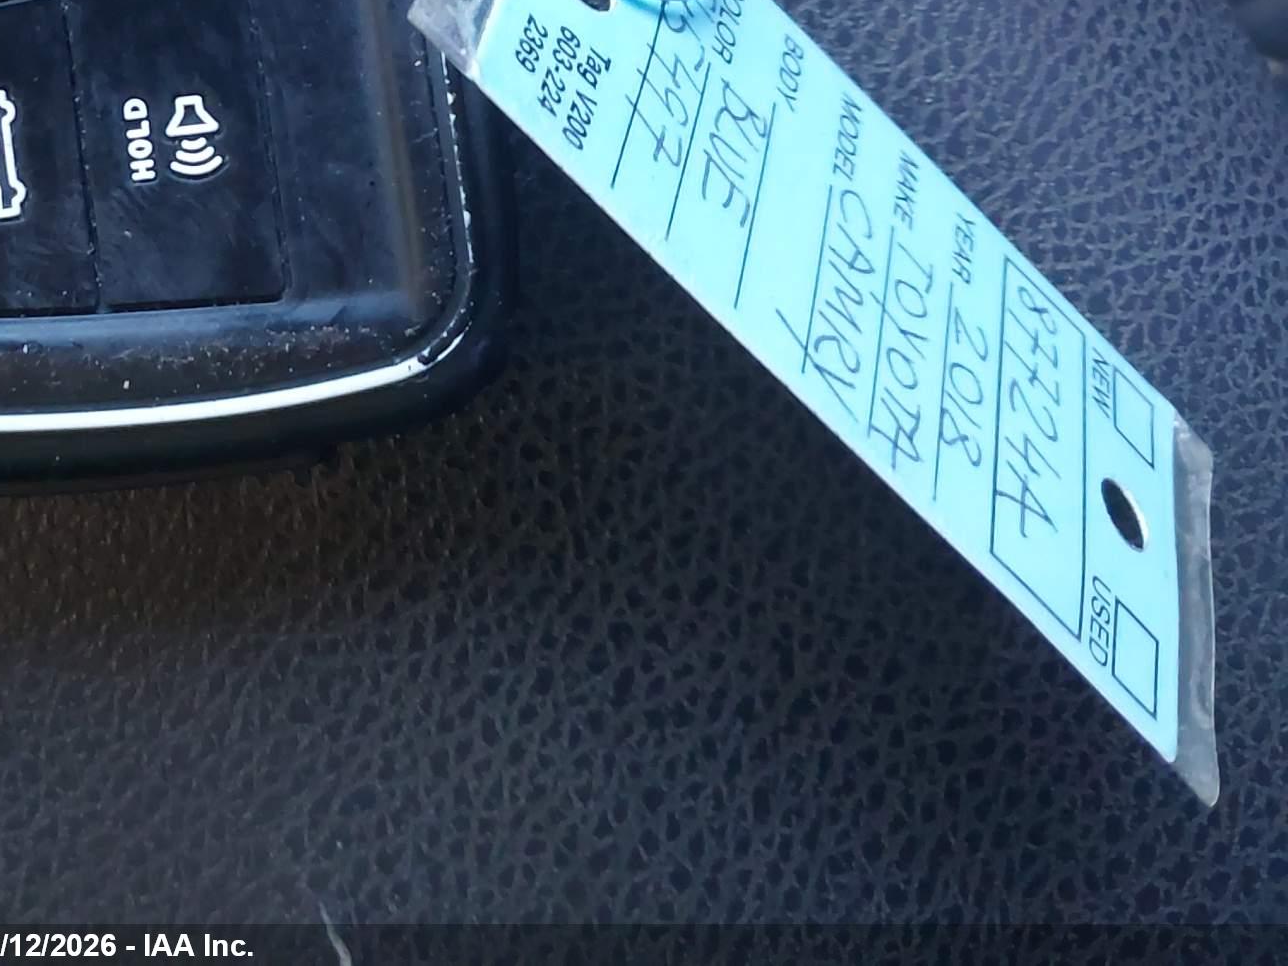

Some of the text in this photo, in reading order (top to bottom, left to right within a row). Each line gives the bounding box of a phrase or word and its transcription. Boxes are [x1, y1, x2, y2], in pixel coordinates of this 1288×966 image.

[516, 13, 548, 74] 2369
[537, 25, 581, 117] 603-224
[777, 33, 804, 113] BODY
[123, 98, 156, 182] HOLD
[562, 47, 611, 151] Tag V200
[832, 94, 862, 182] MODEL
[702, 79, 769, 227] BLUE
[894, 149, 920, 231] MAKE
[951, 211, 976, 285] YEAR
[776, 189, 874, 422] CAMRY
[869, 241, 933, 471] TOYOTA
[940, 306, 988, 467] 2018
[1091, 345, 1114, 420] NEW
[995, 285, 1062, 538] 87724A
[1088, 574, 1113, 667] USED
